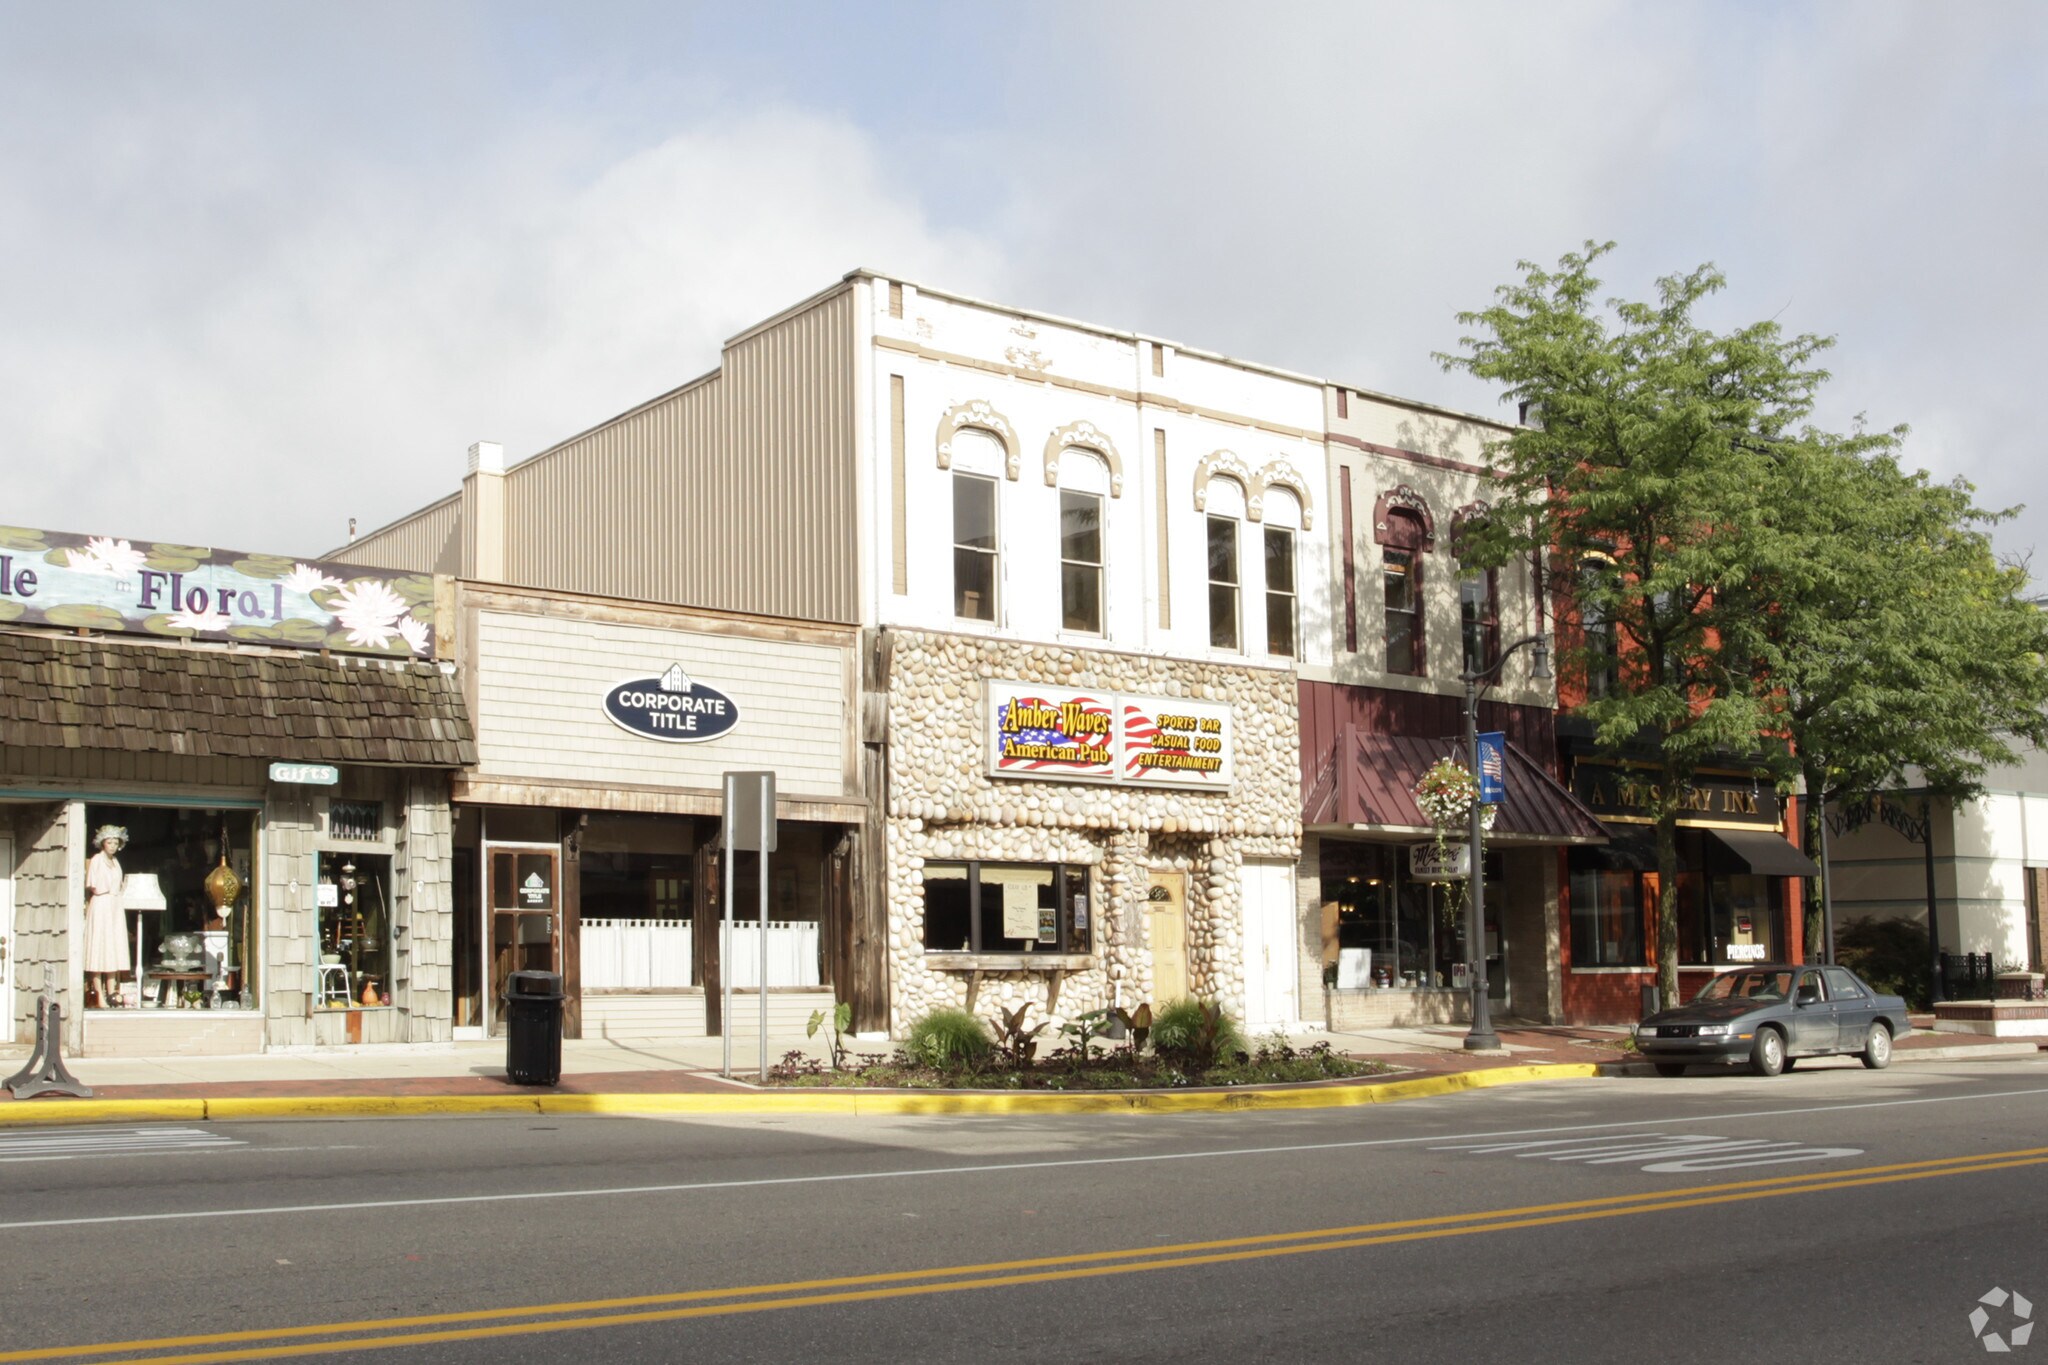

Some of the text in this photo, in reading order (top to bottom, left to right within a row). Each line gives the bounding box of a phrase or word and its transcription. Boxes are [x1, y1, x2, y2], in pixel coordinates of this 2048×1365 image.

[136, 569, 283, 620] Floral
[618, 690, 726, 715] CORPORATE
[649, 711, 697, 731] TITLE
[1001, 696, 1109, 738] Amber Waves
[1156, 713, 1221, 734] SPORTS BAR
[1002, 737, 1110, 765] American Pub
[1150, 733, 1221, 753] CASUAL FOOD
[1138, 752, 1222, 772] ENTERTAINMENT
[274, 766, 331, 782] Gifts
[1591, 782, 1606, 806] A
[1721, 789, 1760, 814] INK
[1726, 943, 1766, 960] PIERCINGS
[1453, 965, 1466, 977] OPEN
